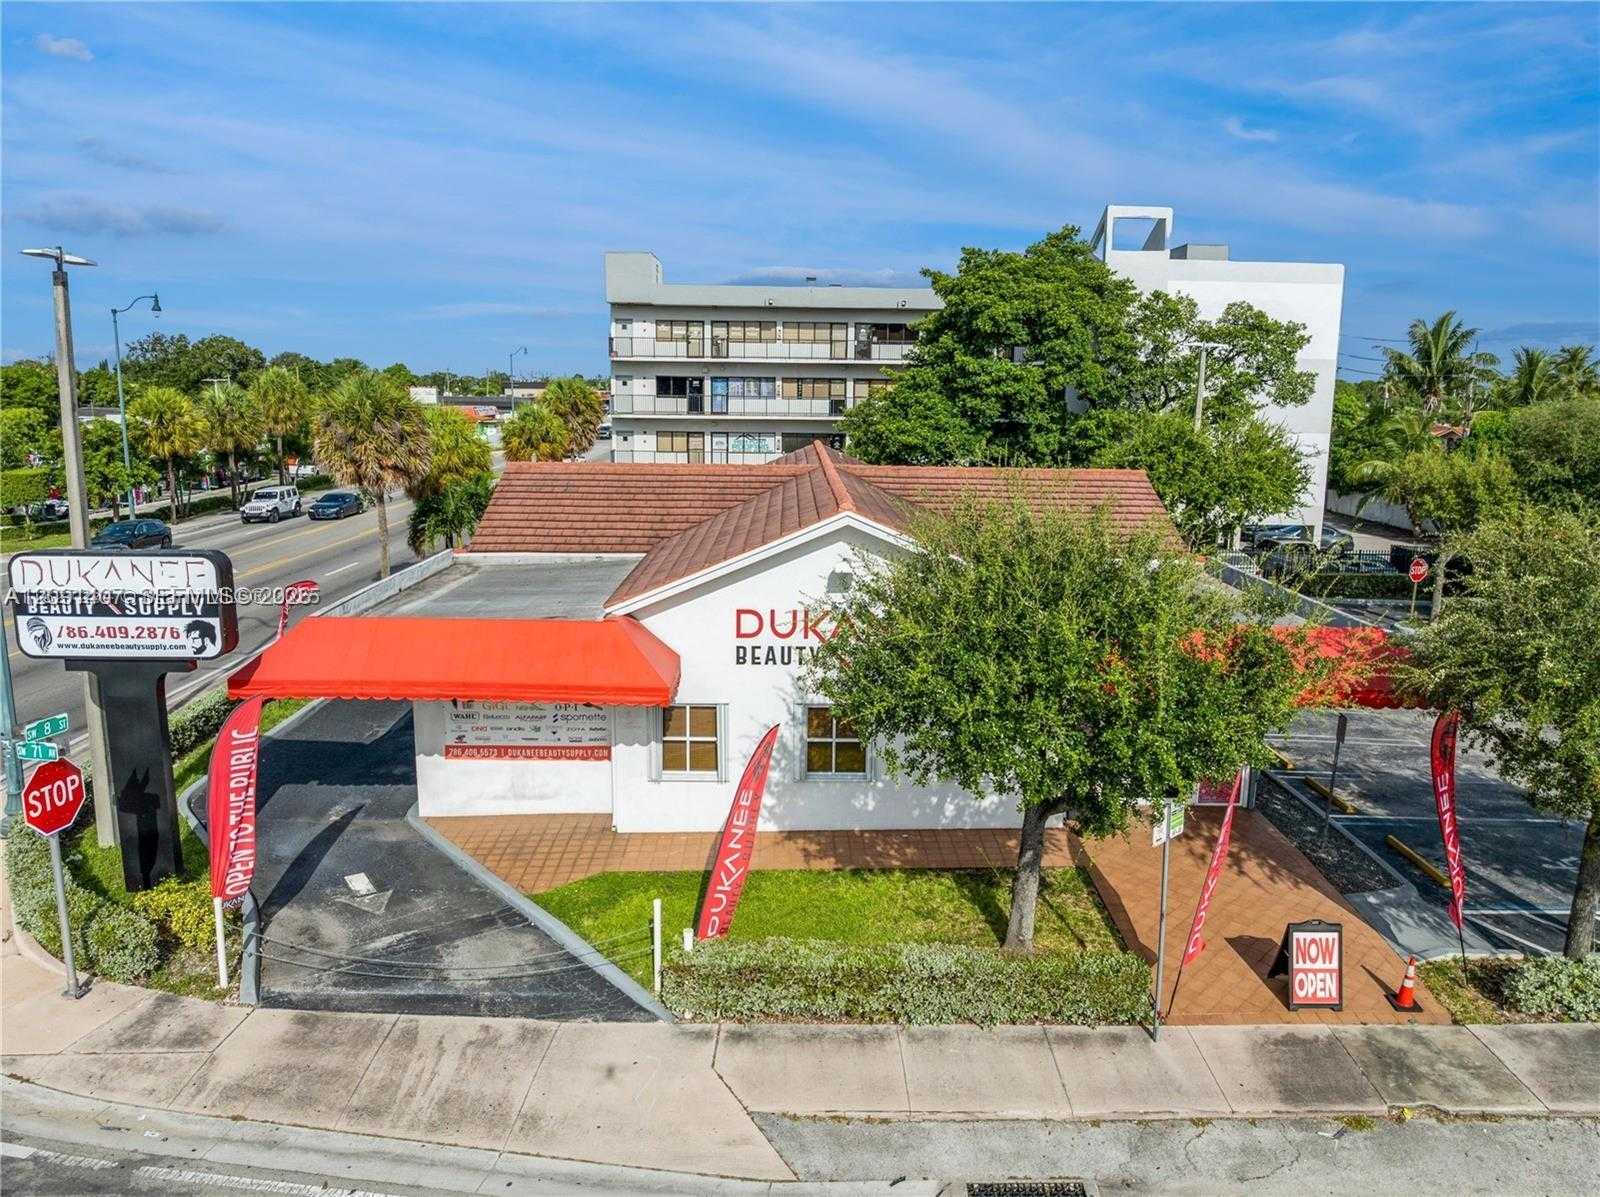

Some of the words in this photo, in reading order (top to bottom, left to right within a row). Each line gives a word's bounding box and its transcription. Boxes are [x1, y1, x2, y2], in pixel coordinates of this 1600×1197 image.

[19, 559, 206, 592] DUKANEE
[1411, 565, 1427, 575] STOP
[28, 595, 93, 615] BEAUTY
[124, 595, 204, 616] SUPPLY
[735, 608, 866, 645] DUKA
[56, 642, 187, 651] www.dukaneebeautysupply.com
[44, 721, 51, 735] 8
[58, 718, 66, 730] ST
[31, 744, 43, 758] 71
[28, 774, 80, 818] STOP
[225, 848, 255, 896] OPEN
[707, 788, 753, 937] DUKANEE
[1295, 937, 1336, 965] NOW
[1295, 973, 1337, 998] OPEN
